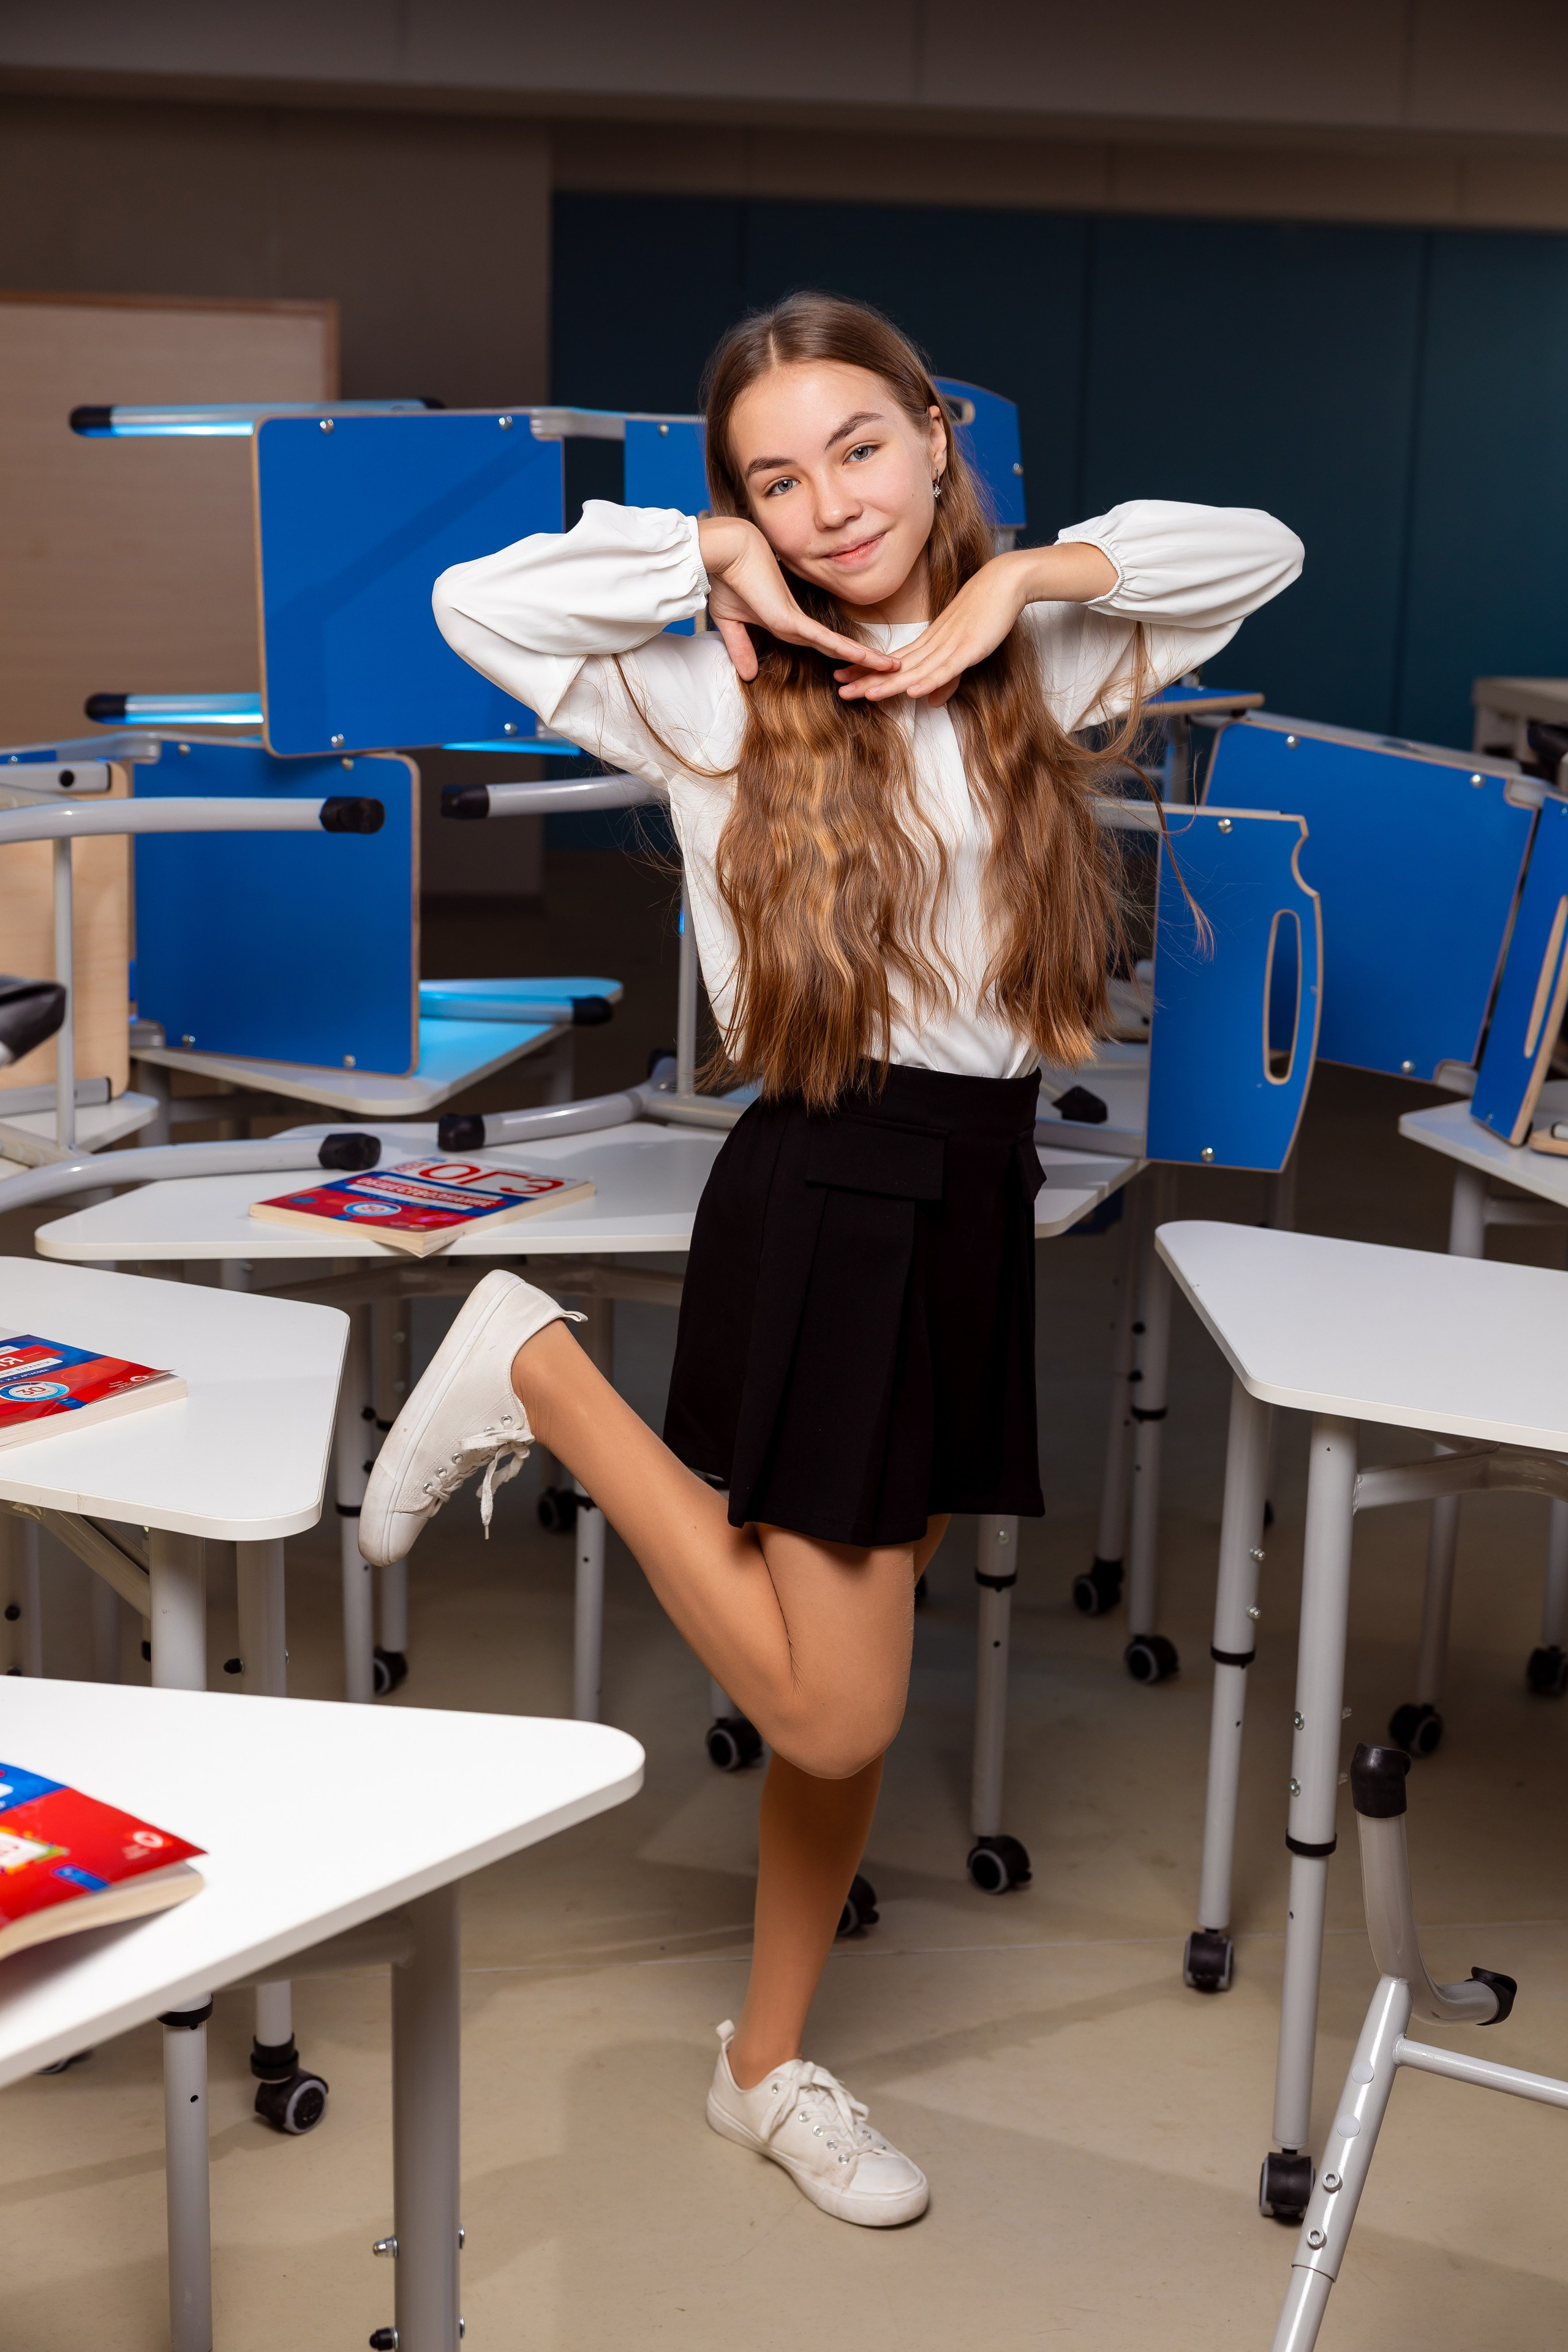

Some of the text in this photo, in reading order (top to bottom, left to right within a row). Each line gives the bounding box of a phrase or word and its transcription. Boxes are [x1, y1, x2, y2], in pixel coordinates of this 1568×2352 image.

[419, 1163, 564, 1194] ОГЭ
[15, 1361, 51, 1371] ВАРИАНТЫ
[15, 1387, 47, 1395] 30
